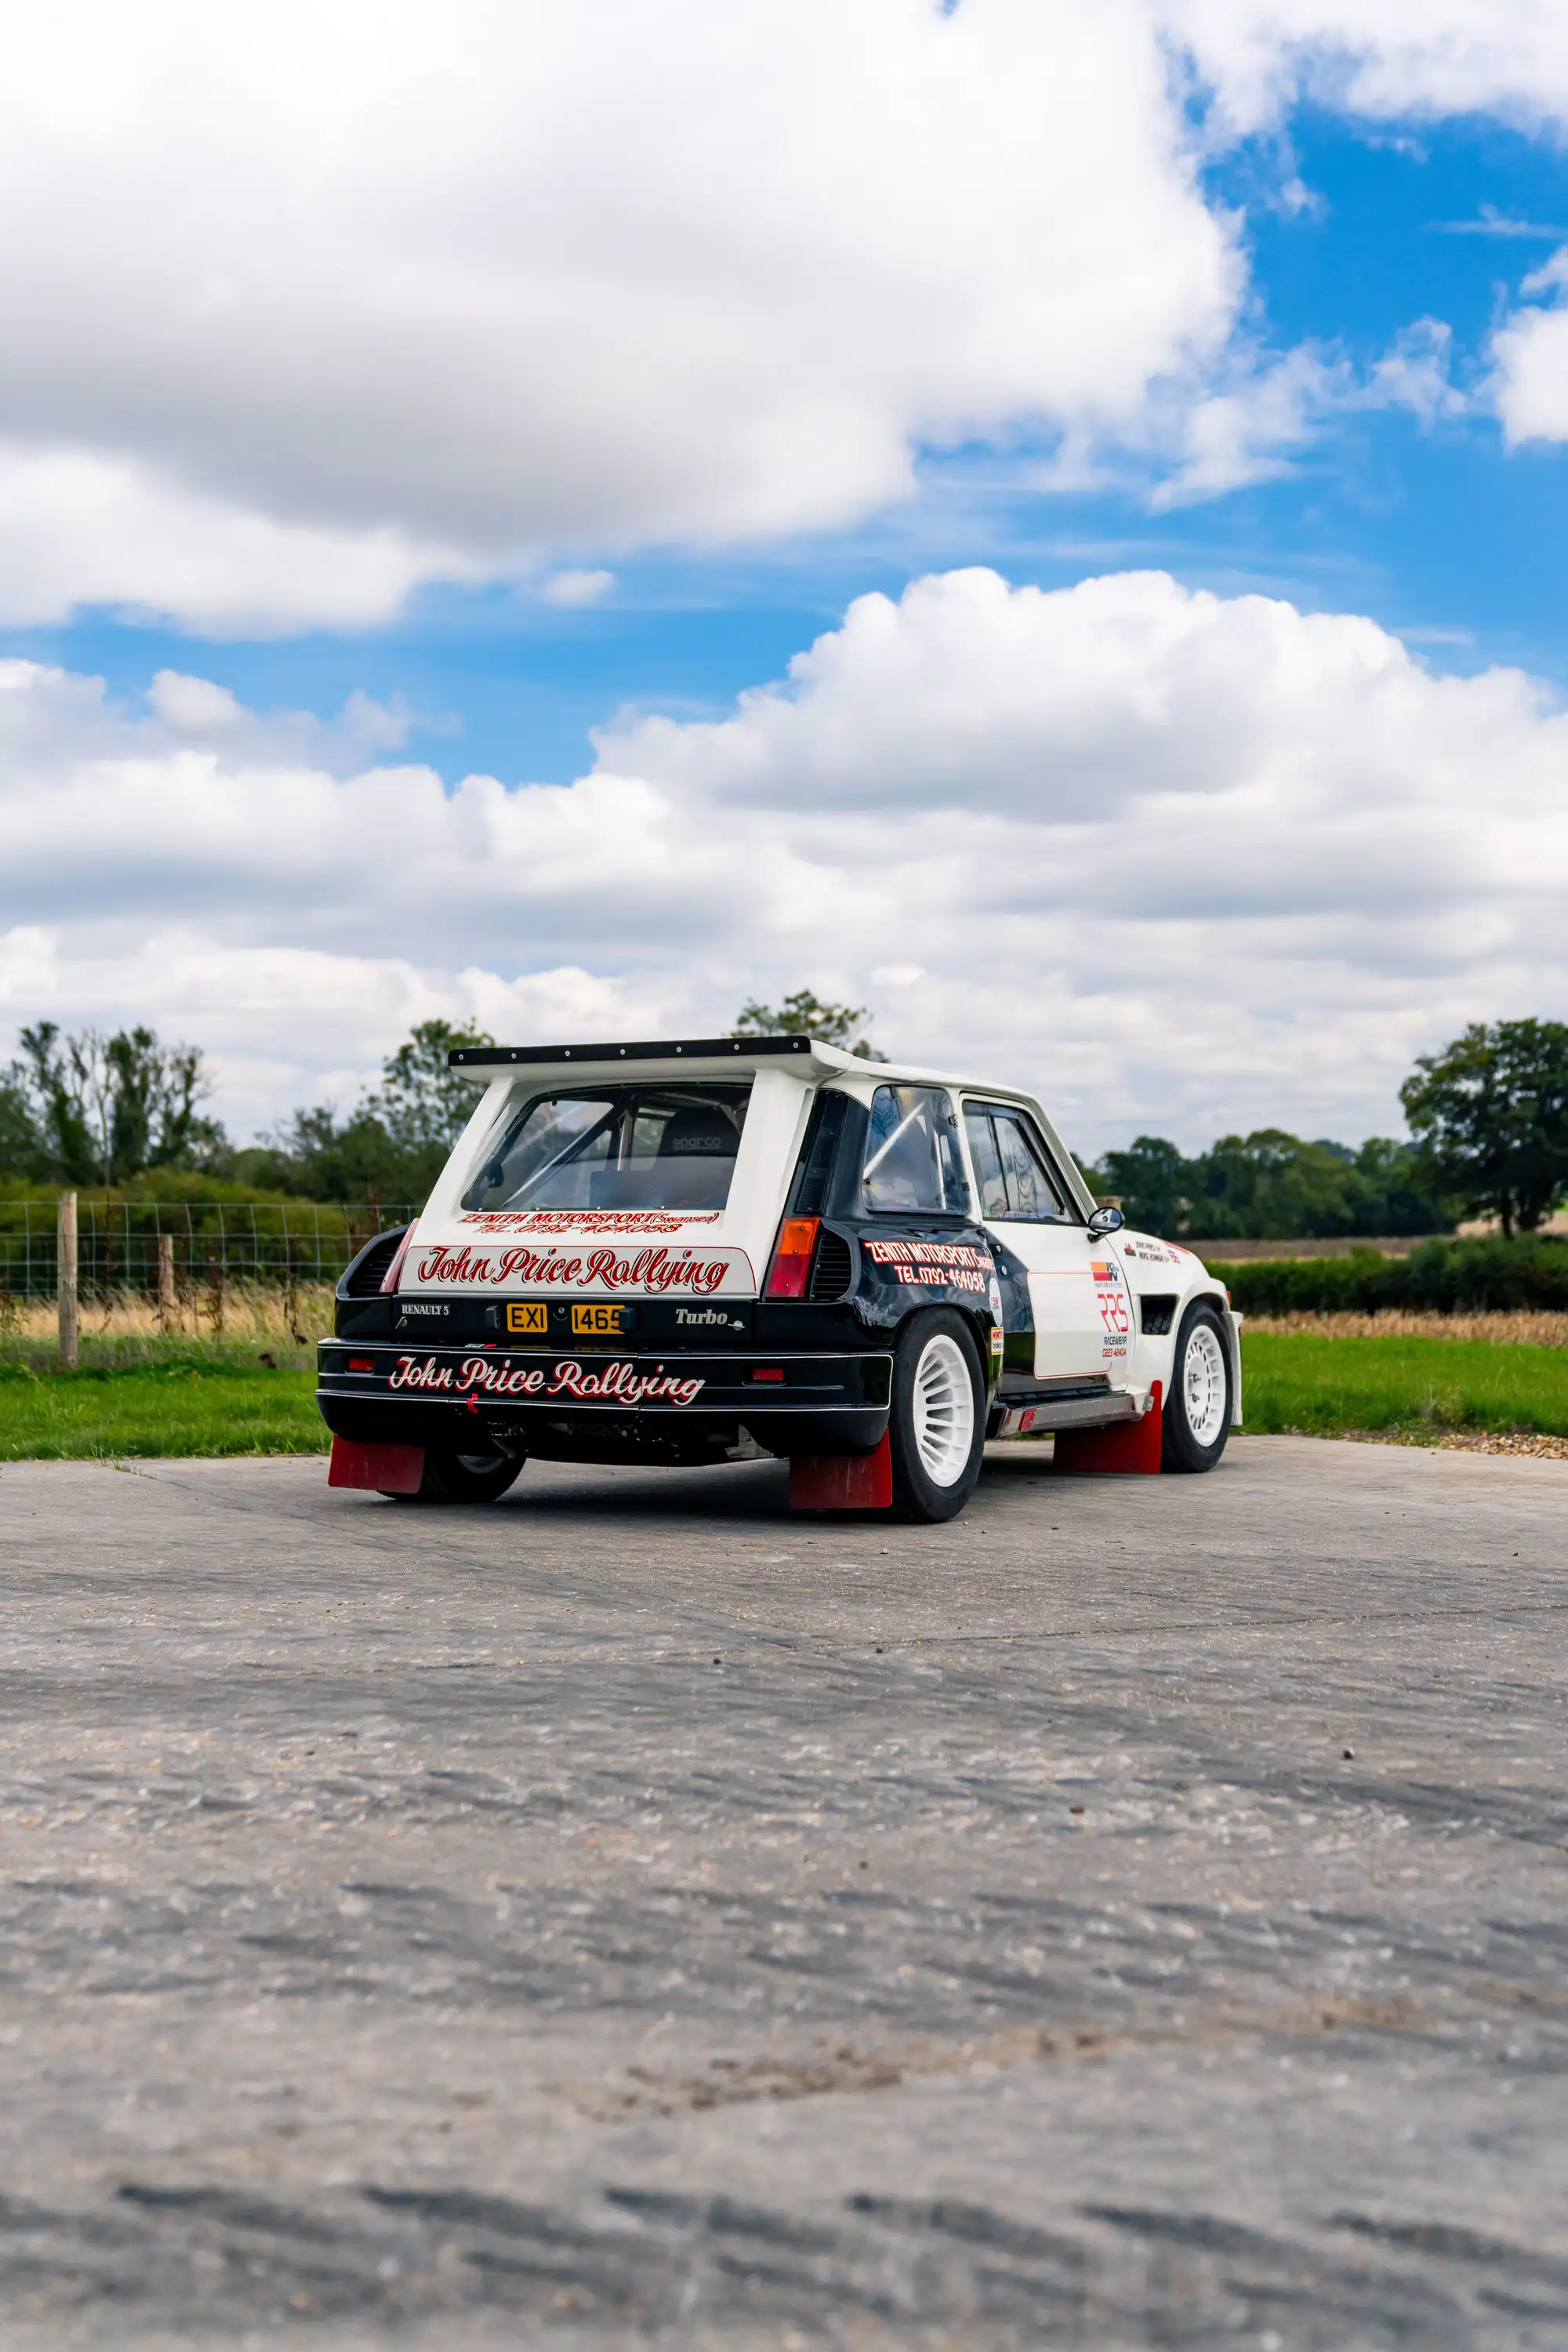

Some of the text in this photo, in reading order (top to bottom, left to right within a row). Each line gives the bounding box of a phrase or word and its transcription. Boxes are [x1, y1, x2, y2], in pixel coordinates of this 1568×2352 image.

[673, 1137, 721, 1151] sparco
[457, 1213, 529, 1224] ZENITH
[863, 1241, 913, 1264] ZENITH
[418, 1247, 731, 1295] John Price Rallying
[401, 1305, 449, 1316] RENAULT 5
[675, 1308, 728, 1325] Turbo
[1103, 1335, 1127, 1346] RACEWEAR
[390, 1356, 706, 1406] John Price Rallying
